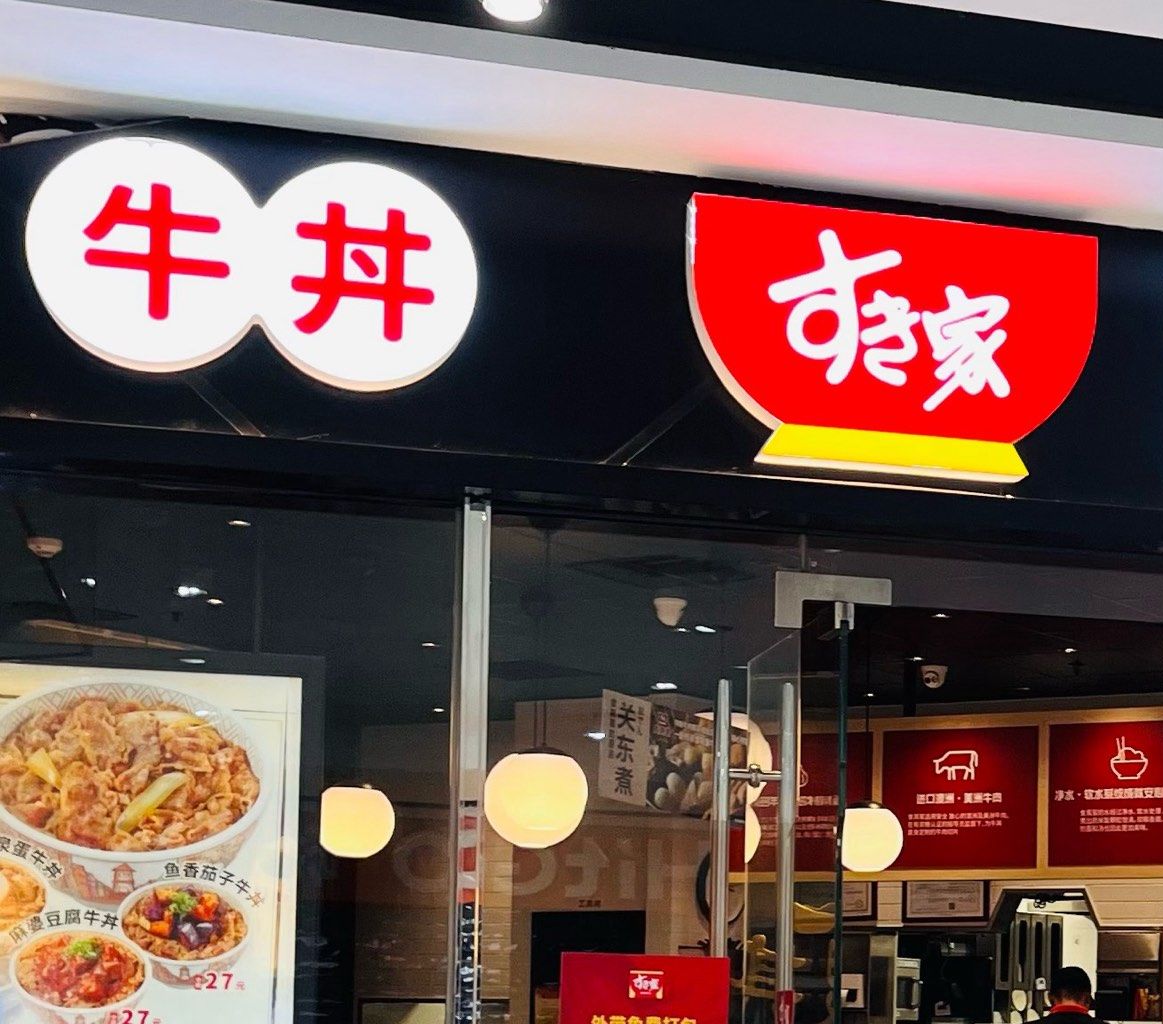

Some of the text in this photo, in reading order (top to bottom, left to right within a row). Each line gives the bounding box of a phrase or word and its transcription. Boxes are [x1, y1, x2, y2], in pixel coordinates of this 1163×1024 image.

[83, 181, 435, 342] 牛丼
[767, 228, 1011, 413] すき家
